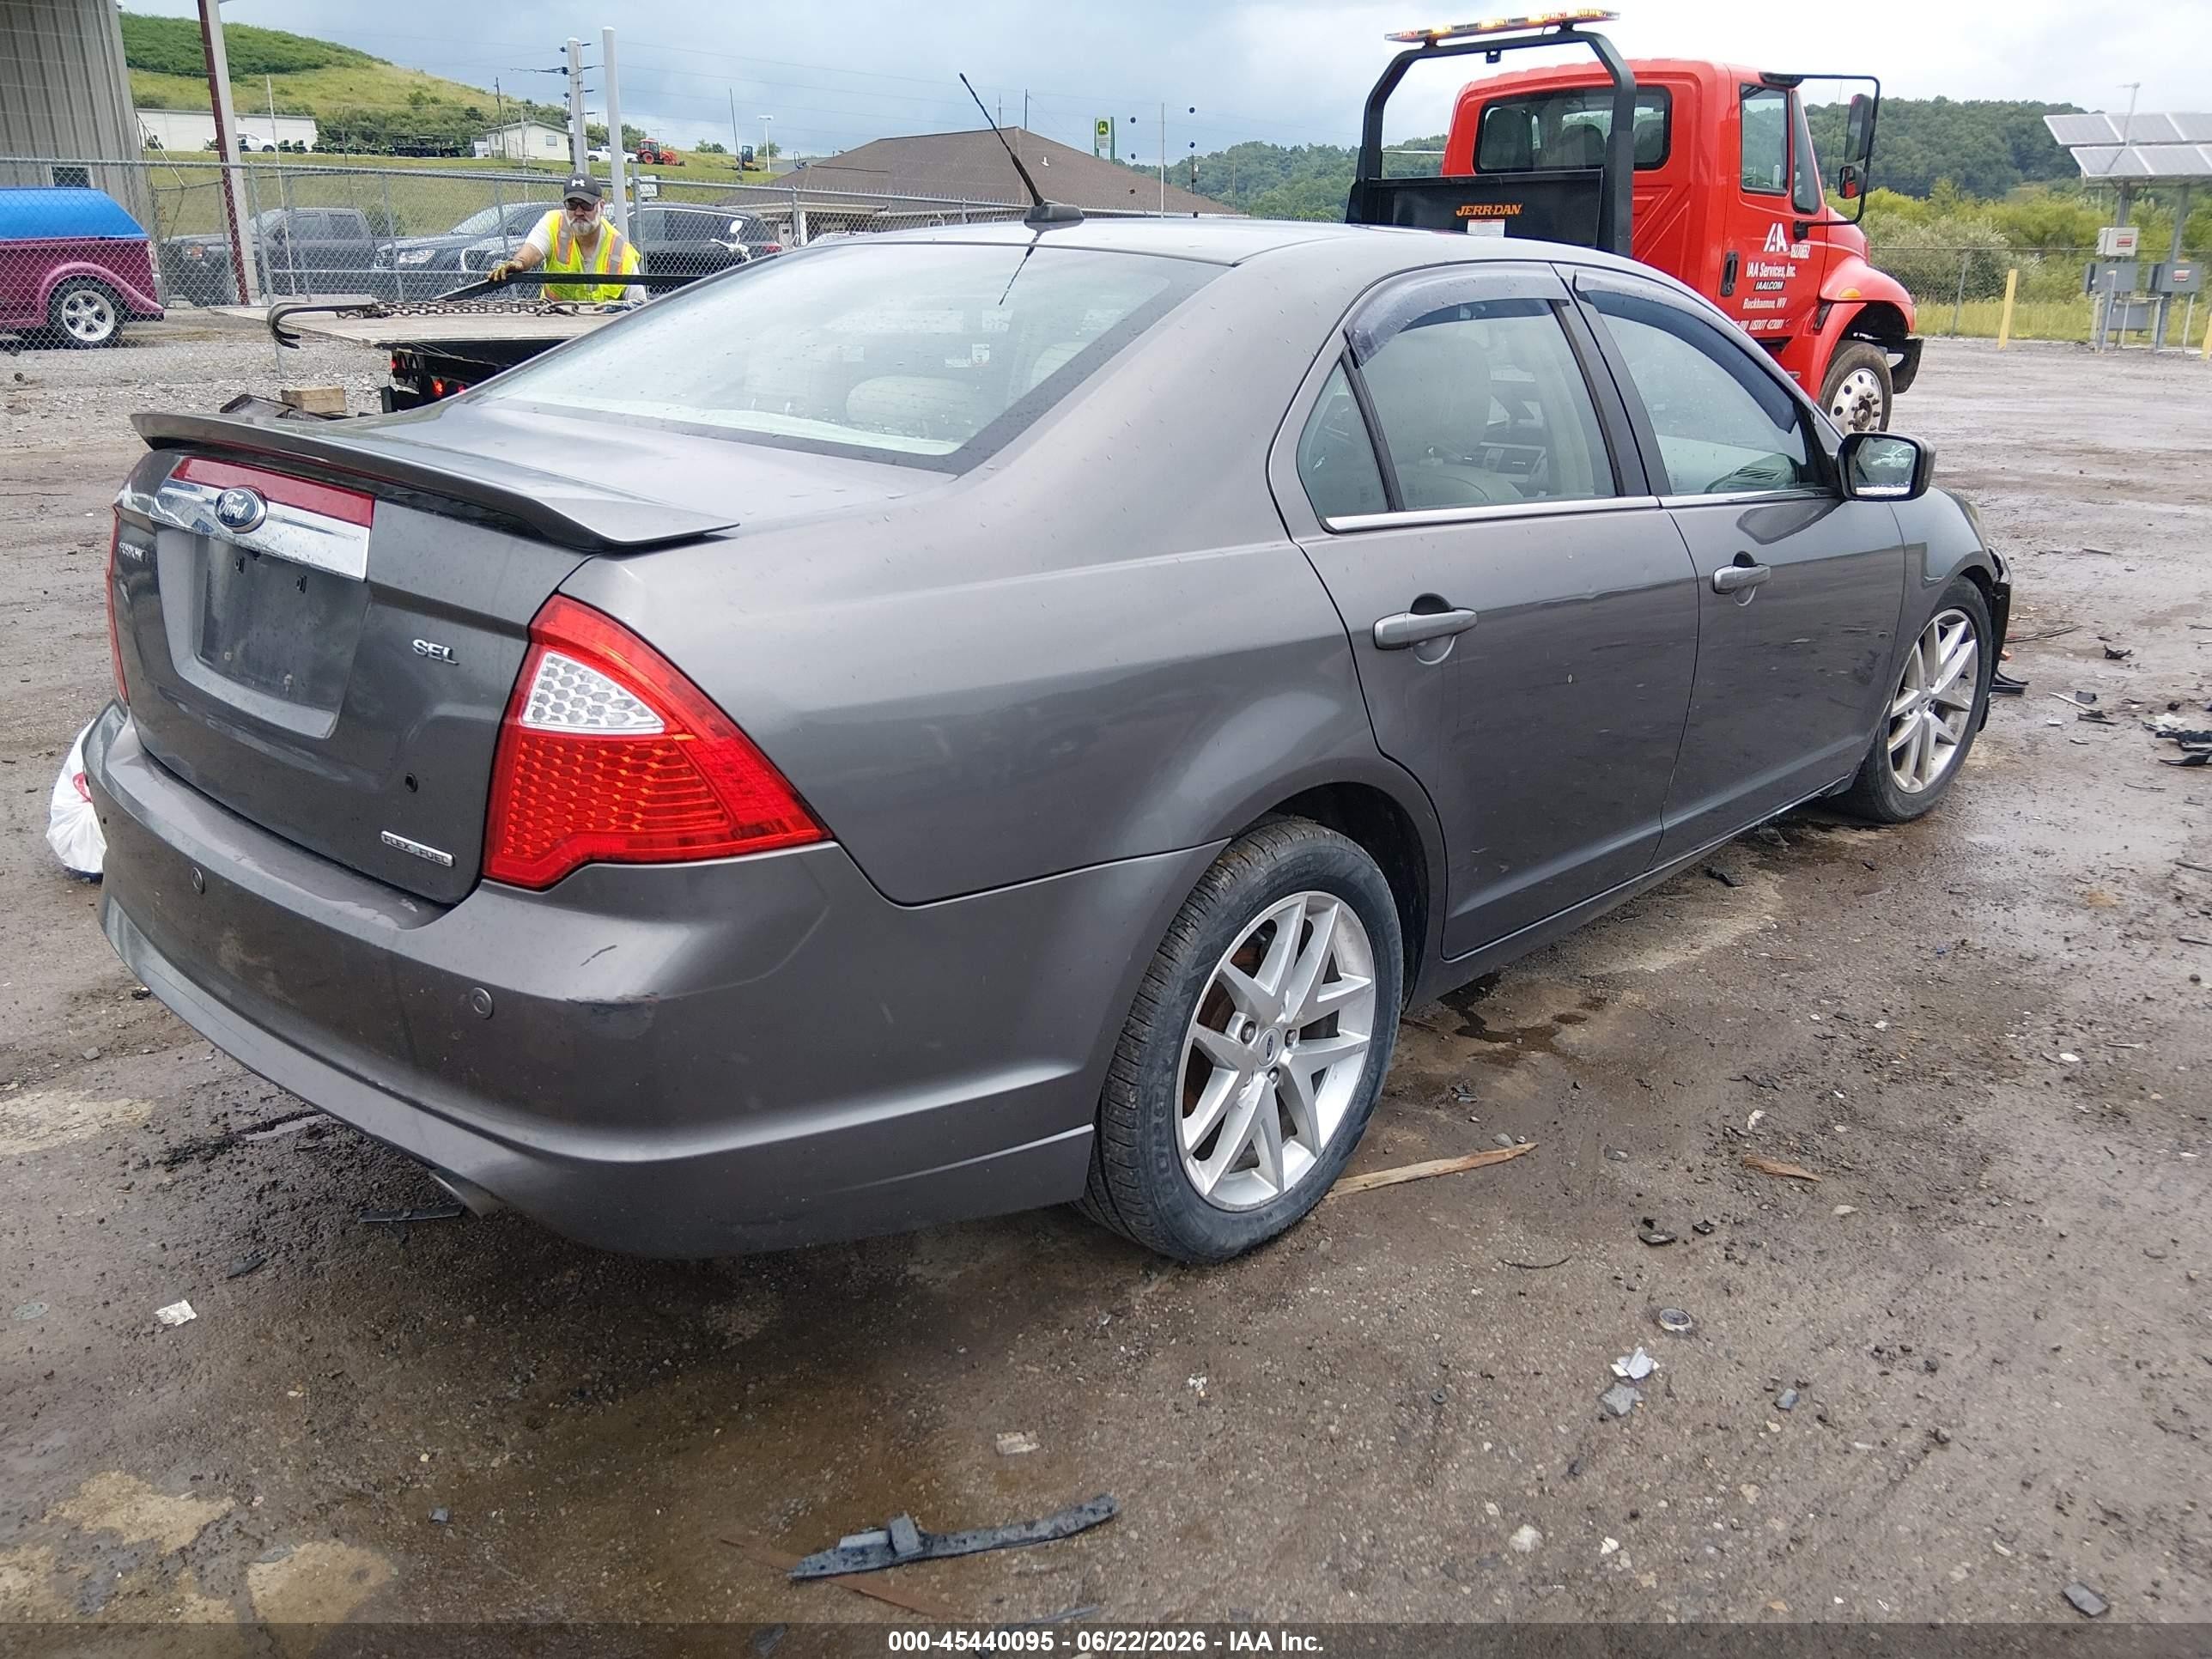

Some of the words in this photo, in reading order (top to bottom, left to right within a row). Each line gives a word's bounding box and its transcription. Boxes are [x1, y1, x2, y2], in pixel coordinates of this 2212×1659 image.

[1746, 261, 1759, 277] IAA
[1759, 261, 1785, 279] Services,
[1777, 297, 1787, 309] WV
[218, 491, 248, 520] Ford
[412, 639, 459, 665] SEL
[418, 849, 451, 866] FUEL
